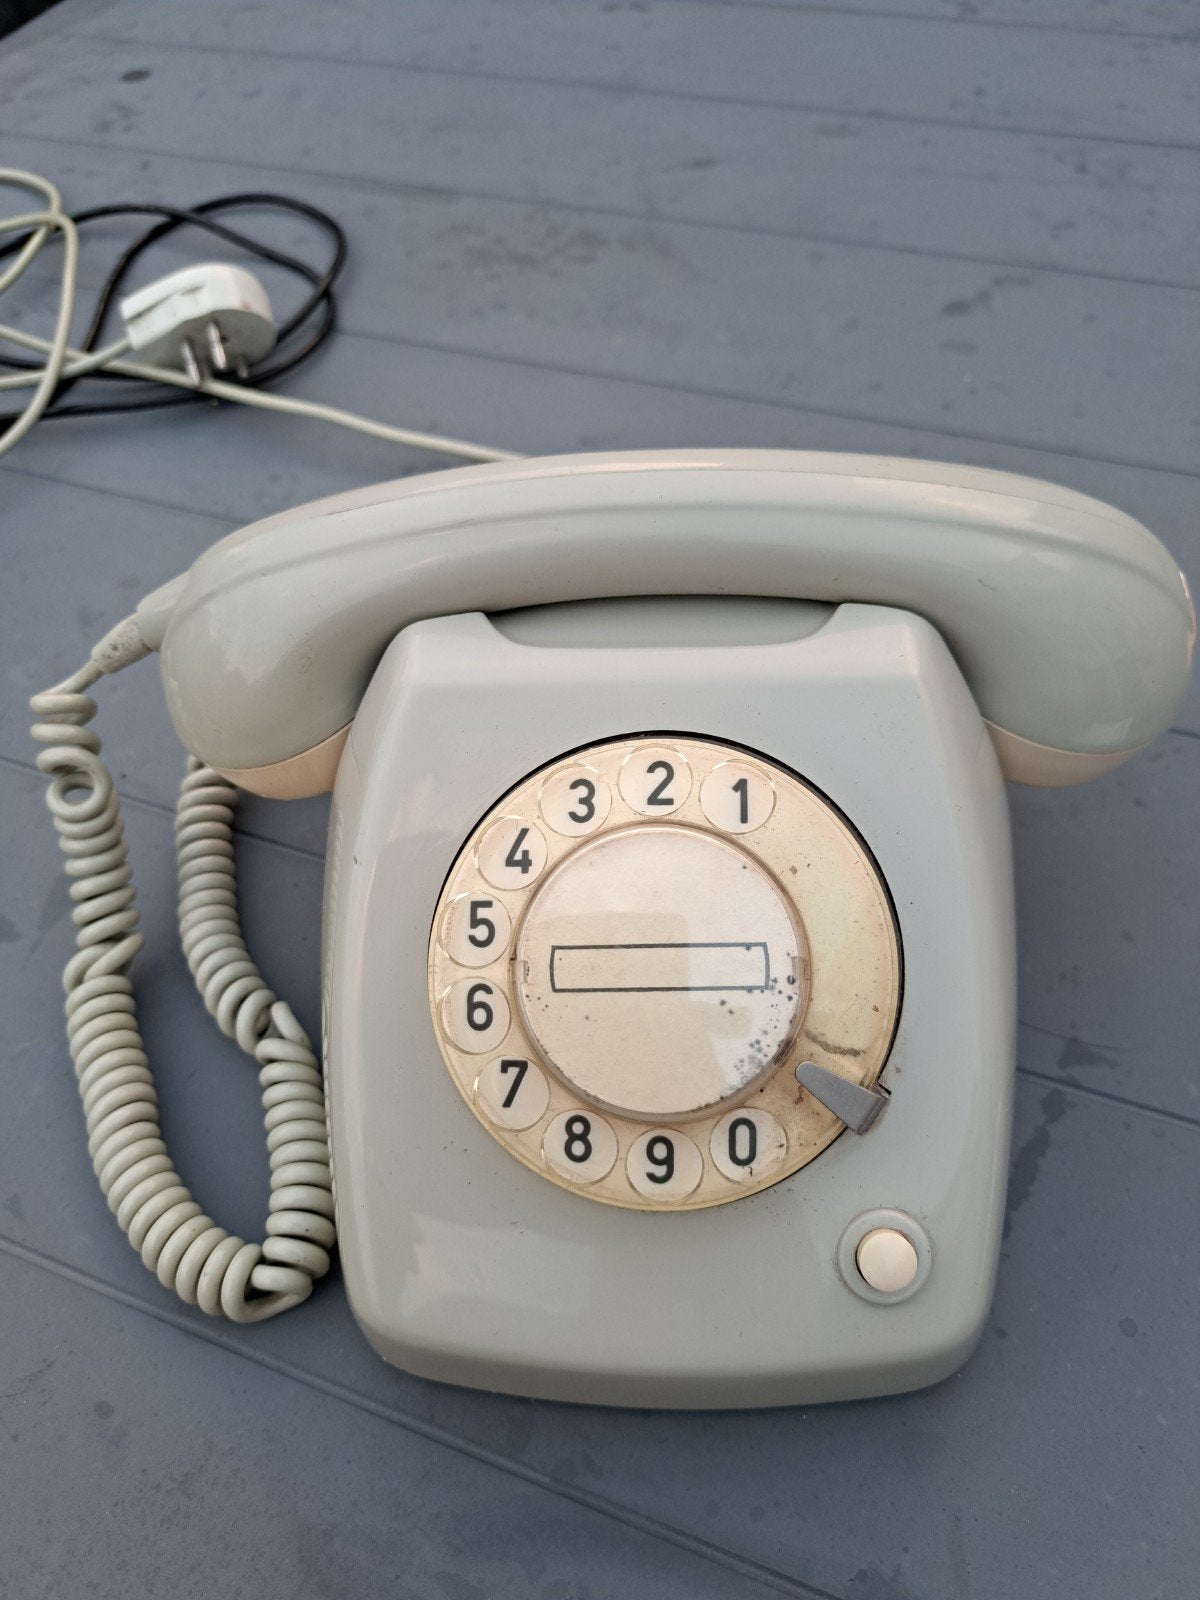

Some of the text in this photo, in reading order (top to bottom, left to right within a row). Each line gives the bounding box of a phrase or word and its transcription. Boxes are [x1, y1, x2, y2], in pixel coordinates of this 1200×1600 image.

[568, 779, 595, 823] 3
[647, 761, 674, 805] 2
[732, 779, 749, 823] 1
[506, 828, 532, 873] 4
[469, 901, 495, 948] 5
[467, 984, 493, 1031] 6
[501, 1060, 528, 1108] 7
[564, 1115, 592, 1162] 8
[646, 1135, 674, 1184] 9
[728, 1117, 757, 1166] 0
